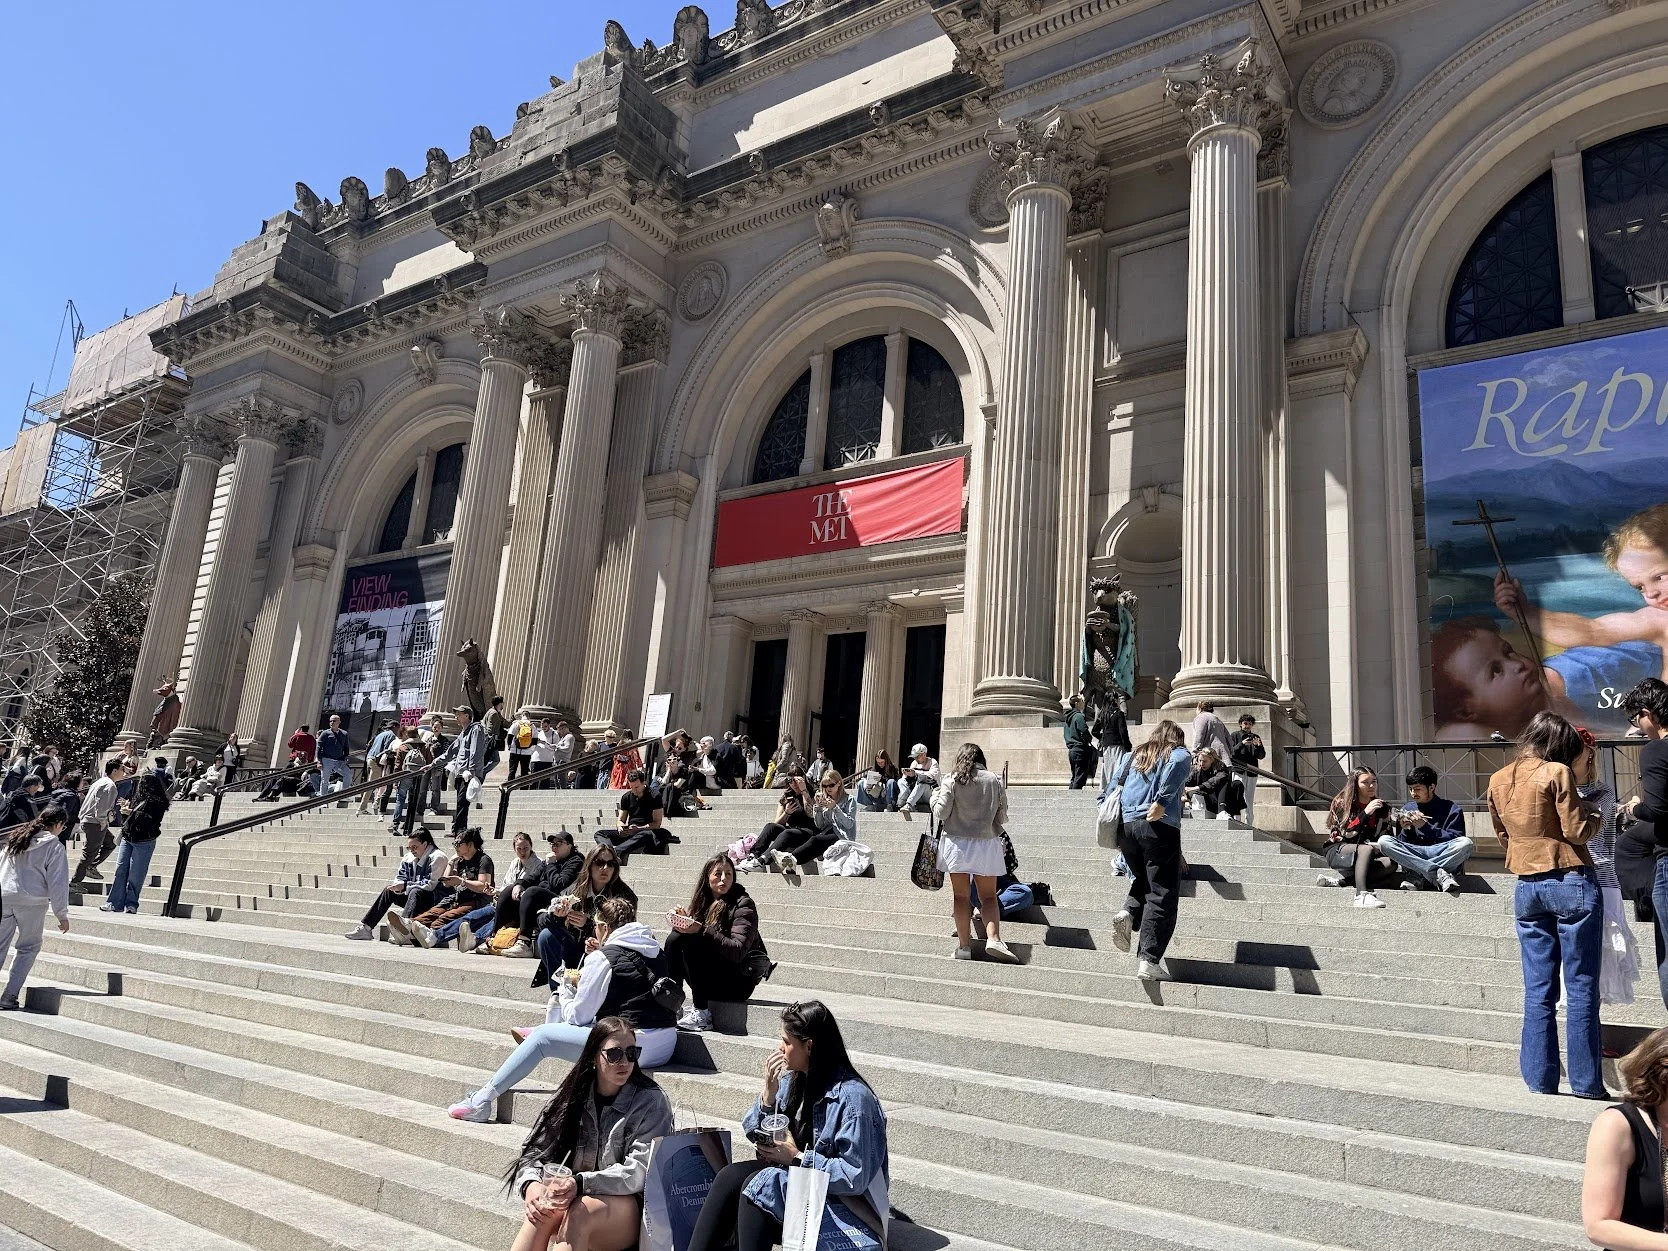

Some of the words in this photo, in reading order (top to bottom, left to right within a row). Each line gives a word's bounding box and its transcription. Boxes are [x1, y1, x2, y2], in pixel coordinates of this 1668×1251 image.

[1461, 366, 1668, 457] Rap
[812, 489, 853, 518] THE
[808, 515, 852, 545] MET
[352, 573, 392, 597] VIEW
[347, 590, 409, 615] FINDING
[401, 708, 428, 717] SELEC
[670, 1178, 714, 1196] Abercrombi
